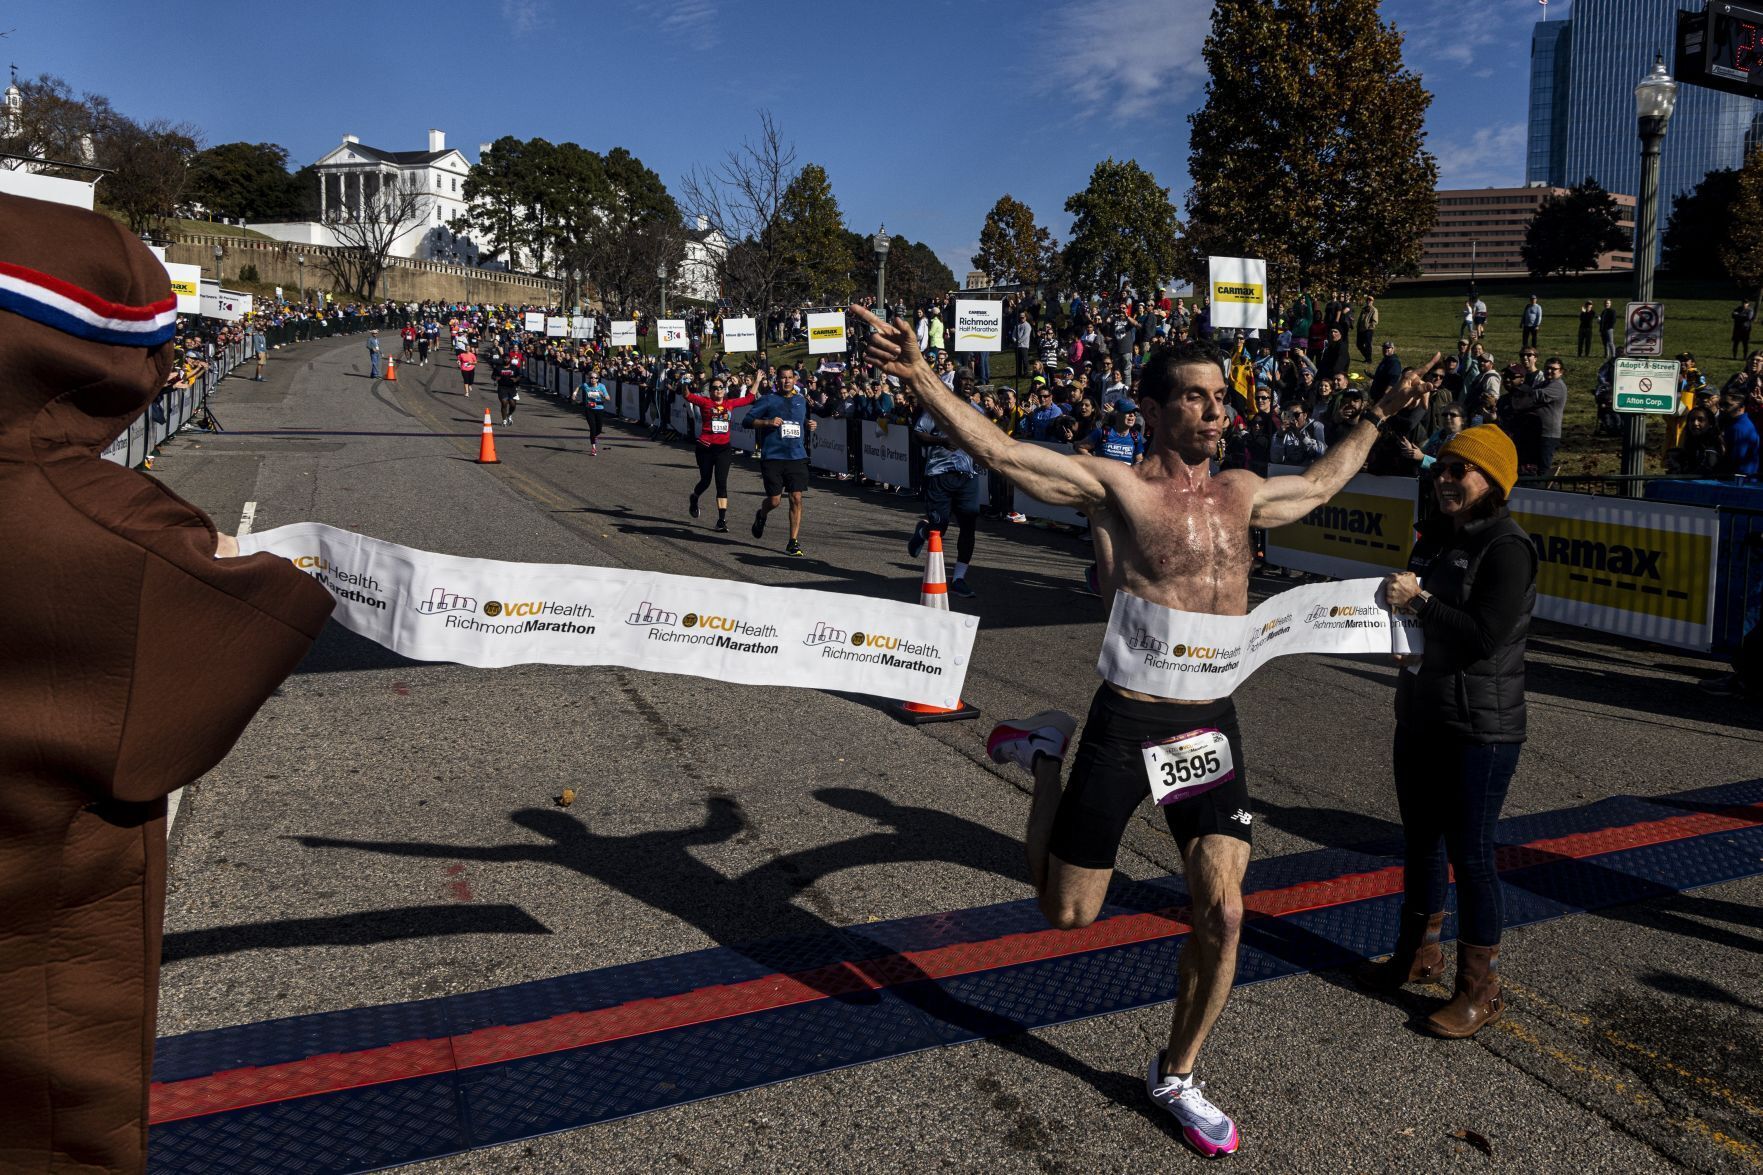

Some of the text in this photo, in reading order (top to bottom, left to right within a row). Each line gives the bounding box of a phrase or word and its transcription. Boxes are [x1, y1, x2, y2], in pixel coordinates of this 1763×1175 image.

[959, 317, 999, 326] Richmond
[1626, 397, 1664, 406] Afton Corp.
[864, 444, 908, 462] Allianz Partners
[1302, 506, 1383, 537] Rmax
[1529, 533, 1662, 581] ARmax
[1151, 752, 1157, 762] 1
[1160, 749, 1221, 787] 3595
